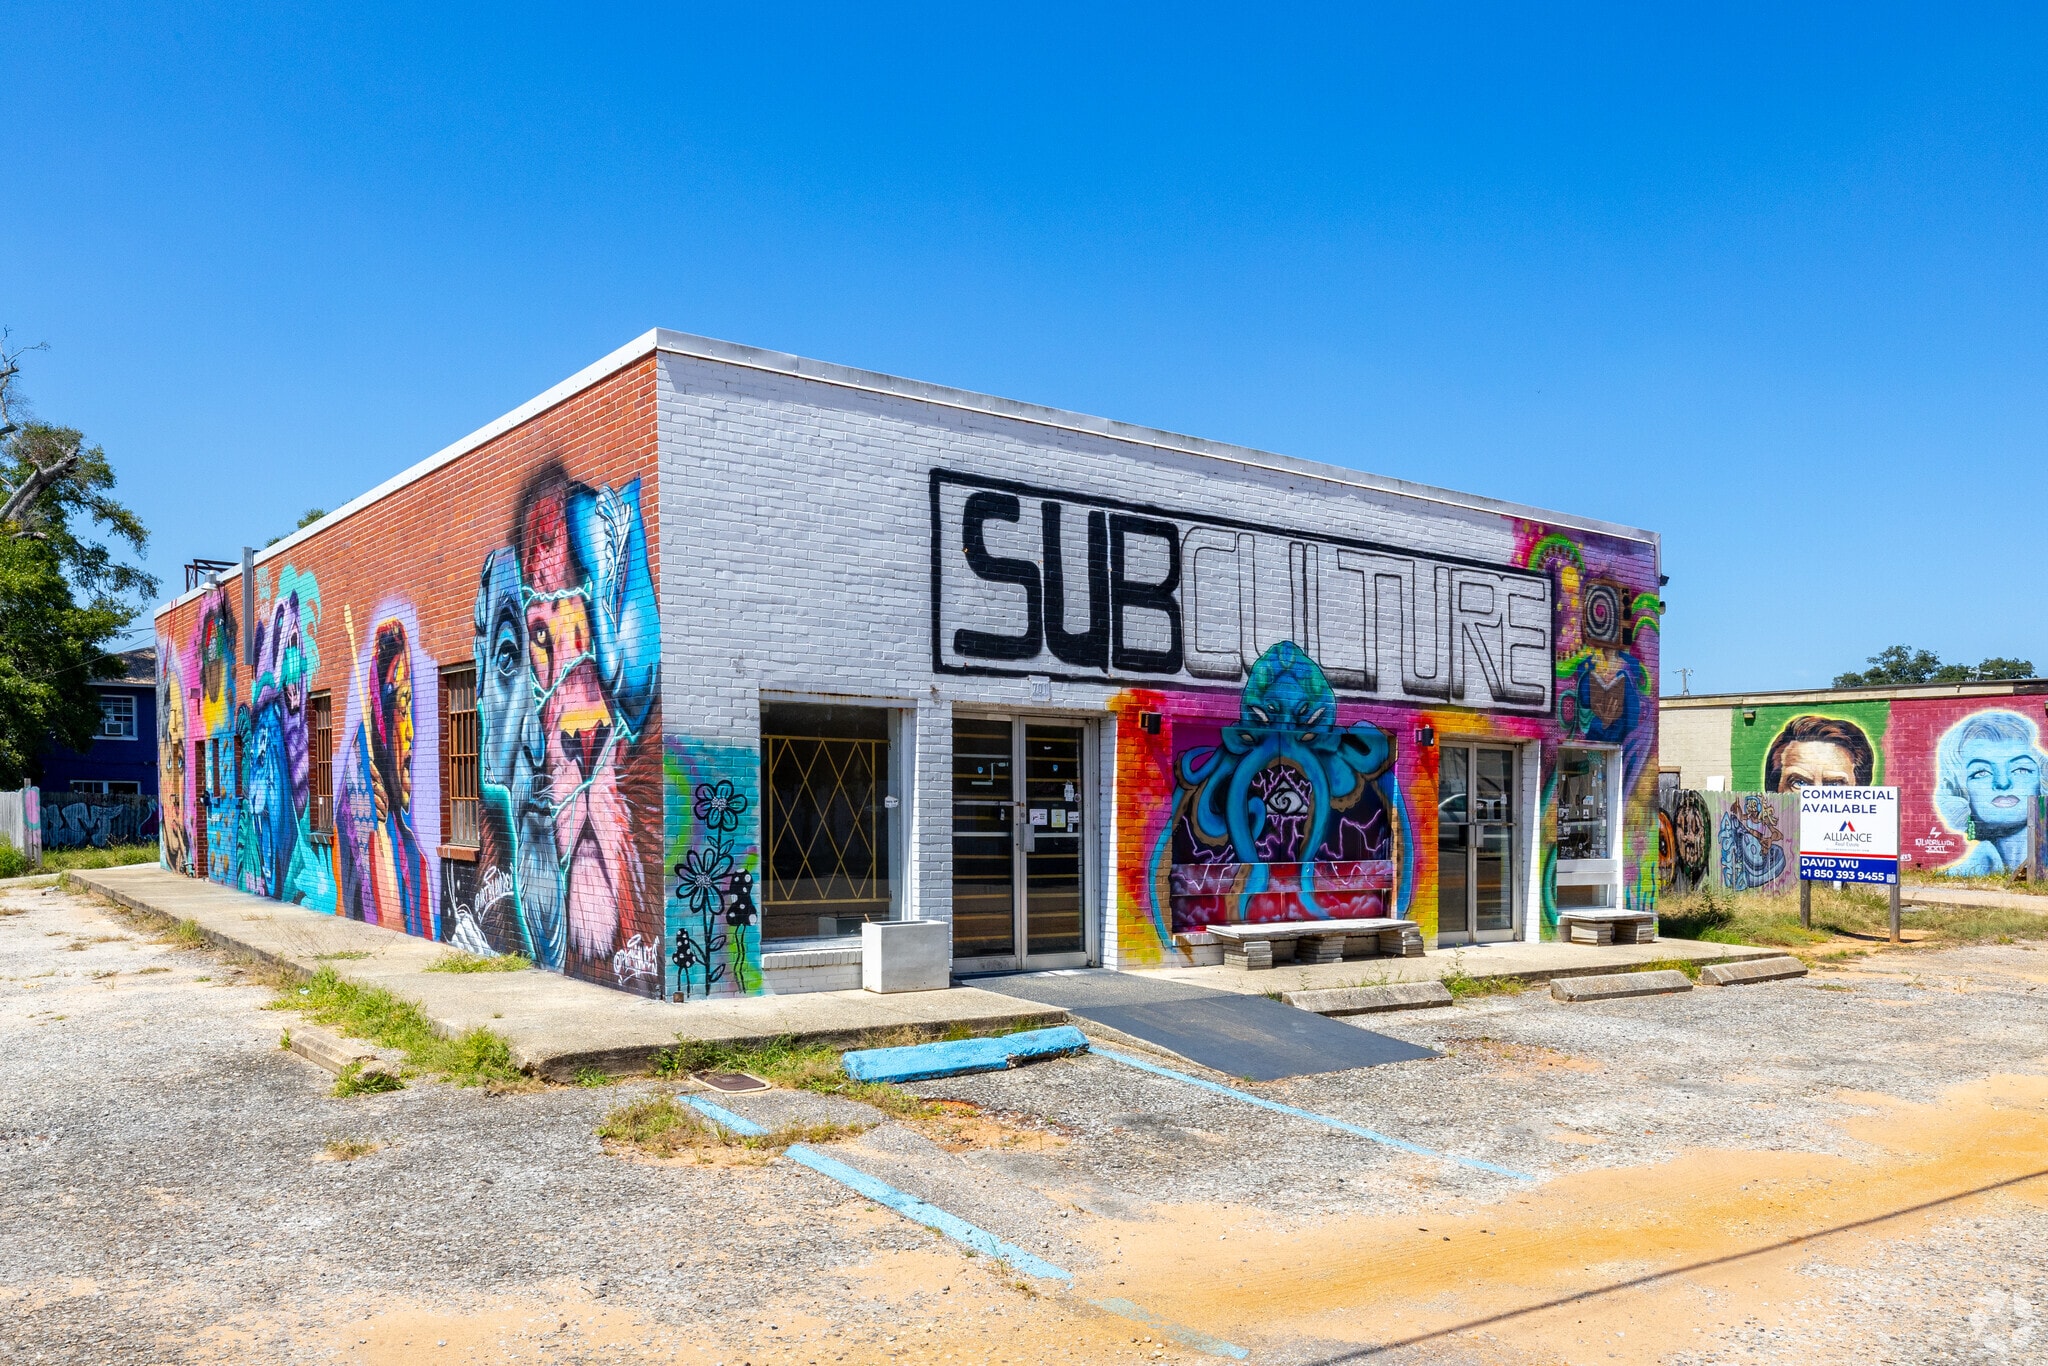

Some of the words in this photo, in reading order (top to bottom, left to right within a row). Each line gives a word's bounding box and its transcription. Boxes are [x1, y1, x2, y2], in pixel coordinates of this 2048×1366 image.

[953, 490, 1547, 704] SUBCULTURE
[1802, 789, 1894, 800] COMMERCIAL
[1802, 803, 1877, 814] AVAILABLE
[1823, 832, 1873, 843] ALLIANCE
[1801, 858, 1837, 868] DAVID
[1839, 860, 1859, 869] WU
[1801, 869, 1811, 877] +1
[1814, 869, 1834, 879] 850
[1836, 870, 1855, 880] 393
[1857, 872, 1885, 881] 9455
